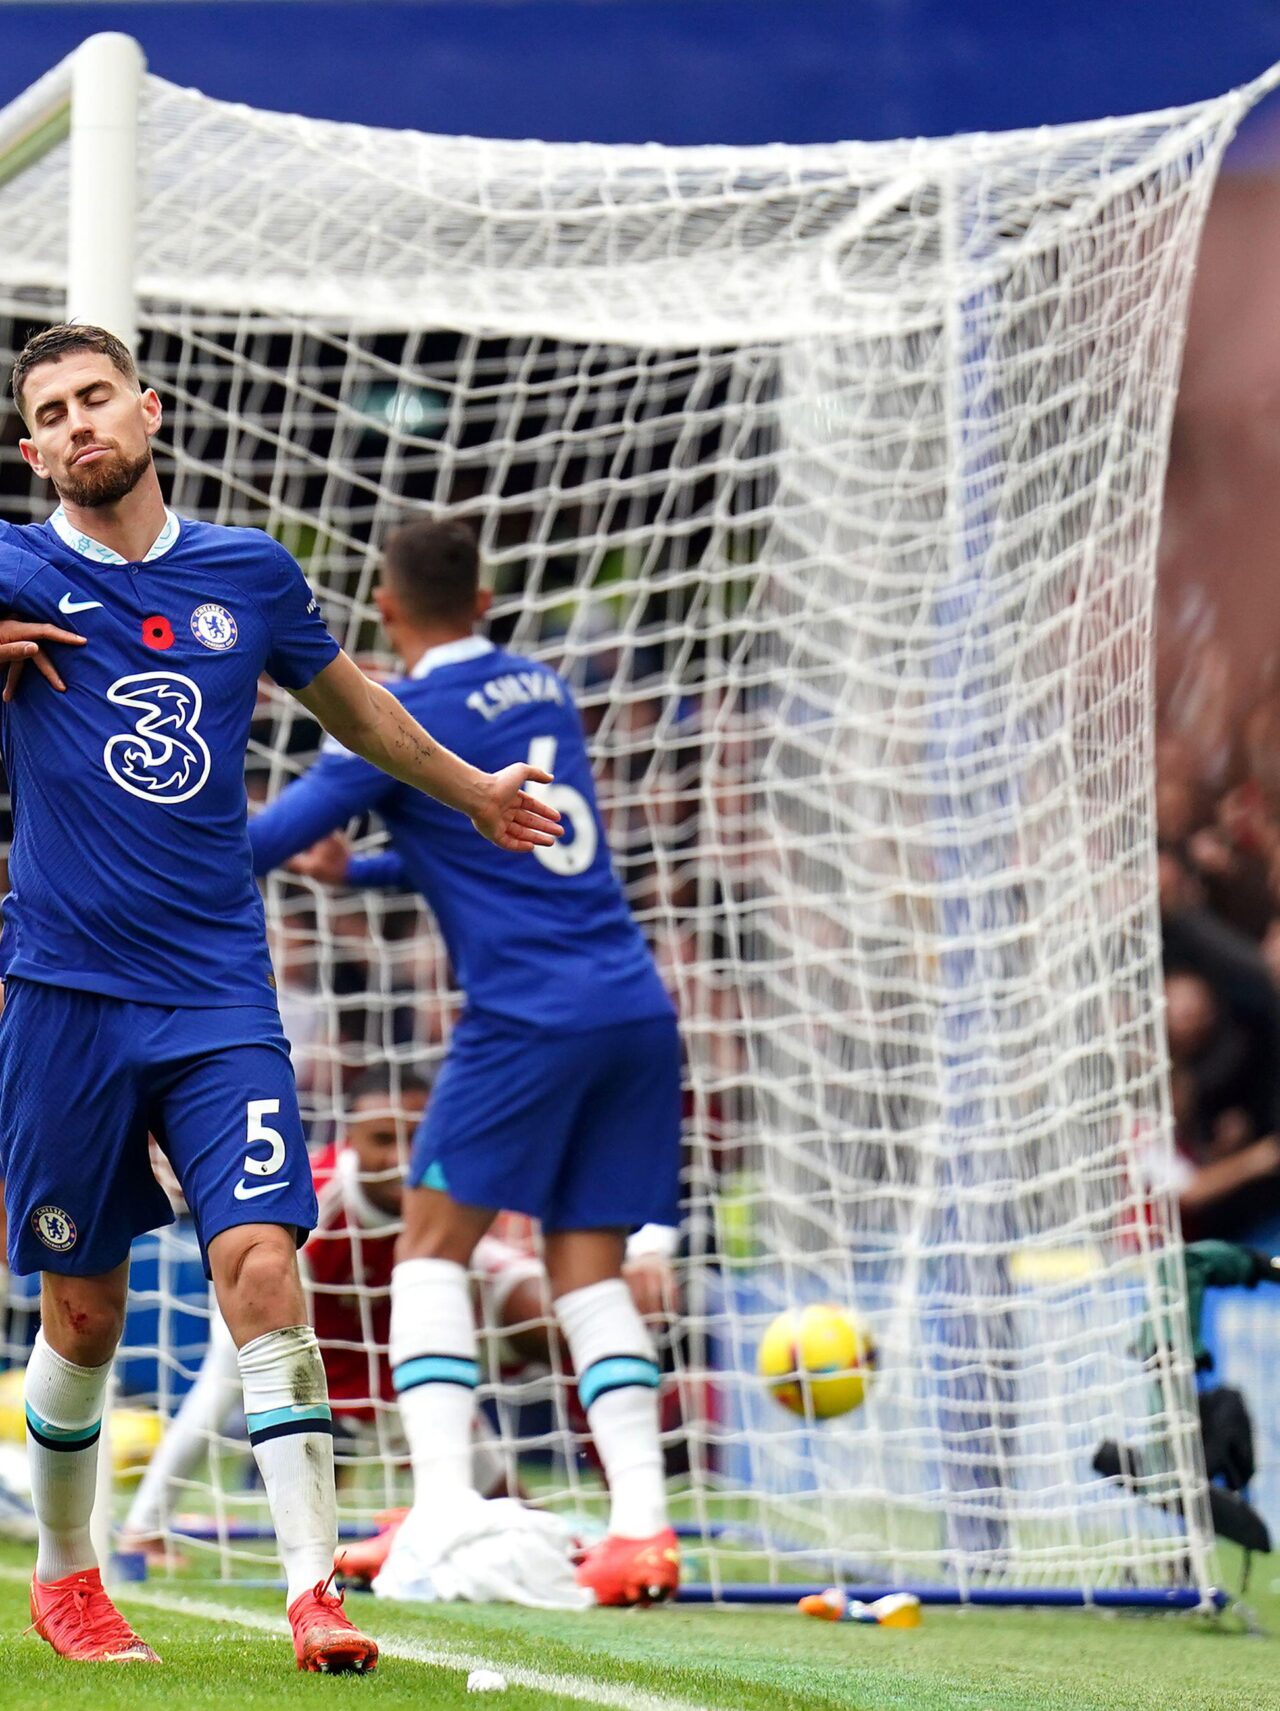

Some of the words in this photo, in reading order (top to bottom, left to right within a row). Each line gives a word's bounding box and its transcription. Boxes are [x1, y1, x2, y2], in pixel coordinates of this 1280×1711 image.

[195, 604, 225, 617] CHELSEA
[104, 670, 211, 804] 3
[524, 735, 599, 876] 6
[243, 1098, 286, 1176] 5
[36, 1207, 66, 1219] CHELSEA
